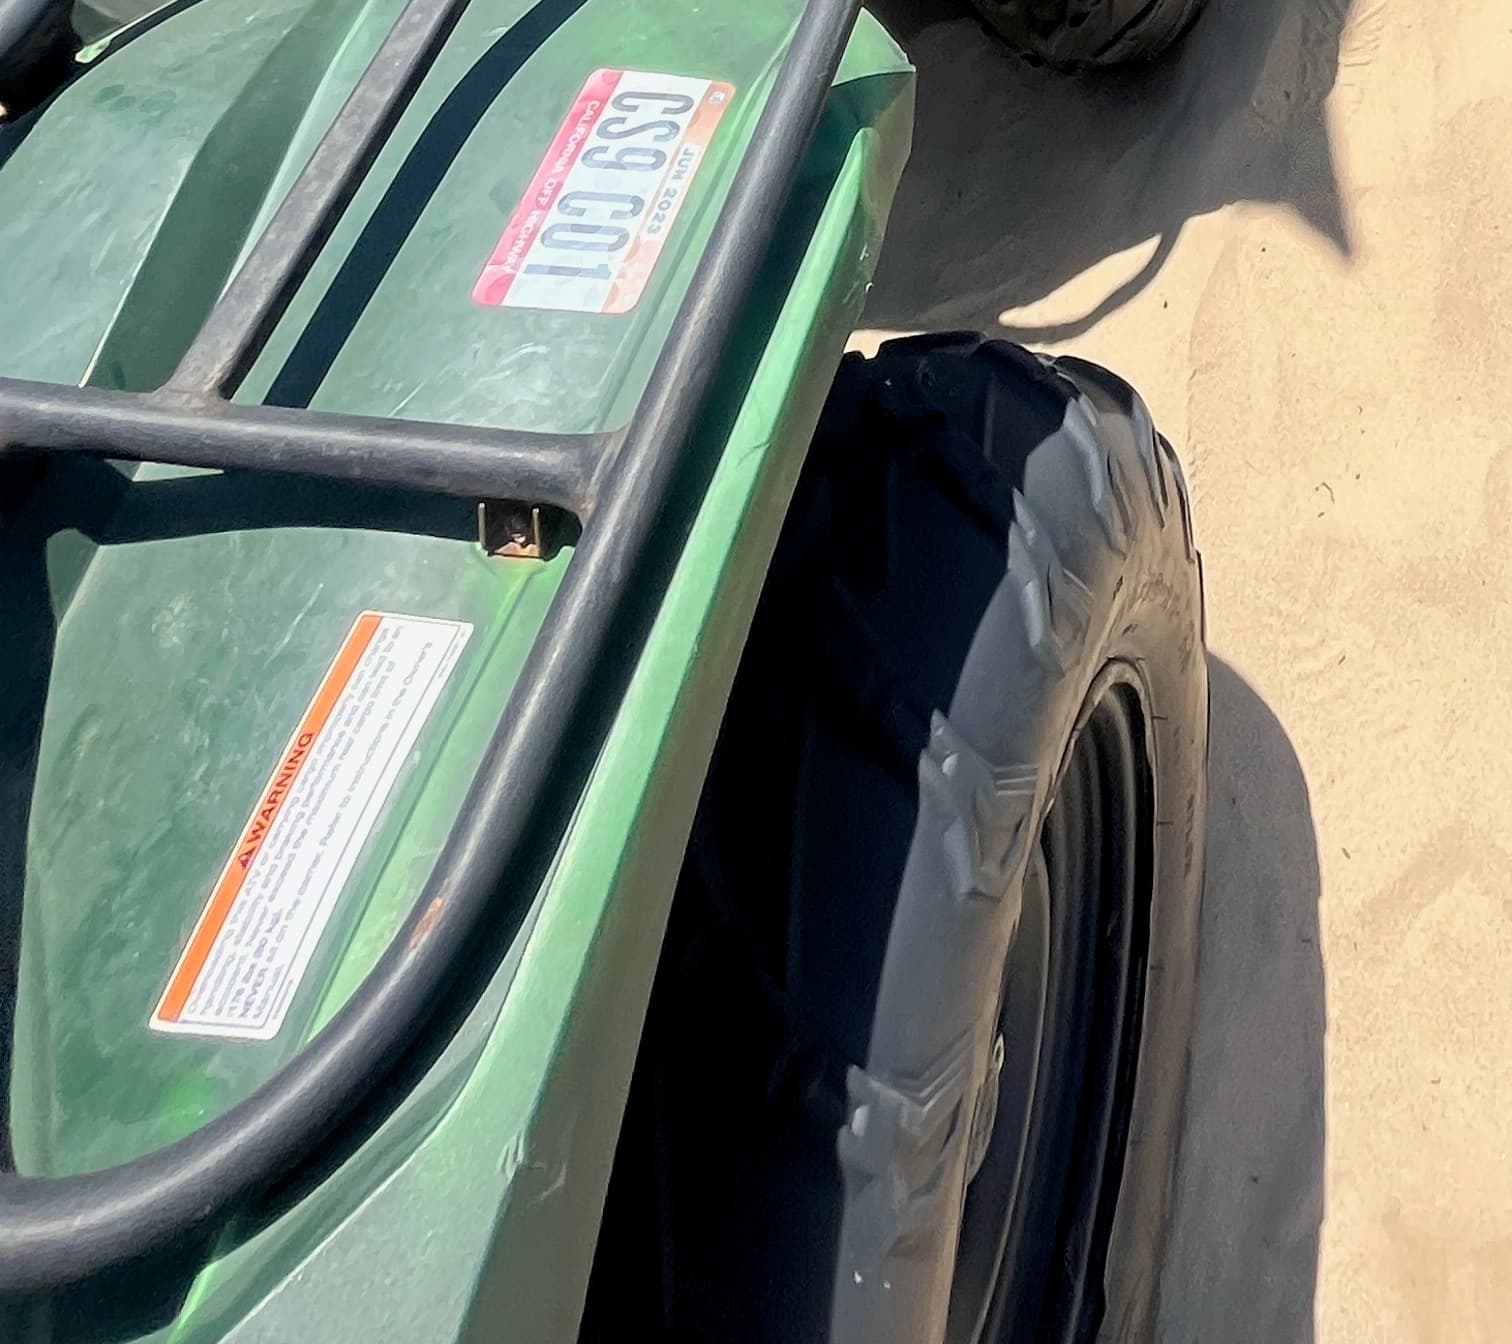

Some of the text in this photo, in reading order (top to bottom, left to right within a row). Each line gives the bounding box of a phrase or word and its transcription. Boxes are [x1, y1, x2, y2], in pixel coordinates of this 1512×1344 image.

[502, 101, 599, 273] CALIFORNIA OFF HIGHWAY
[648, 147, 695, 234] JUN 2023
[245, 730, 314, 845] WARNING
